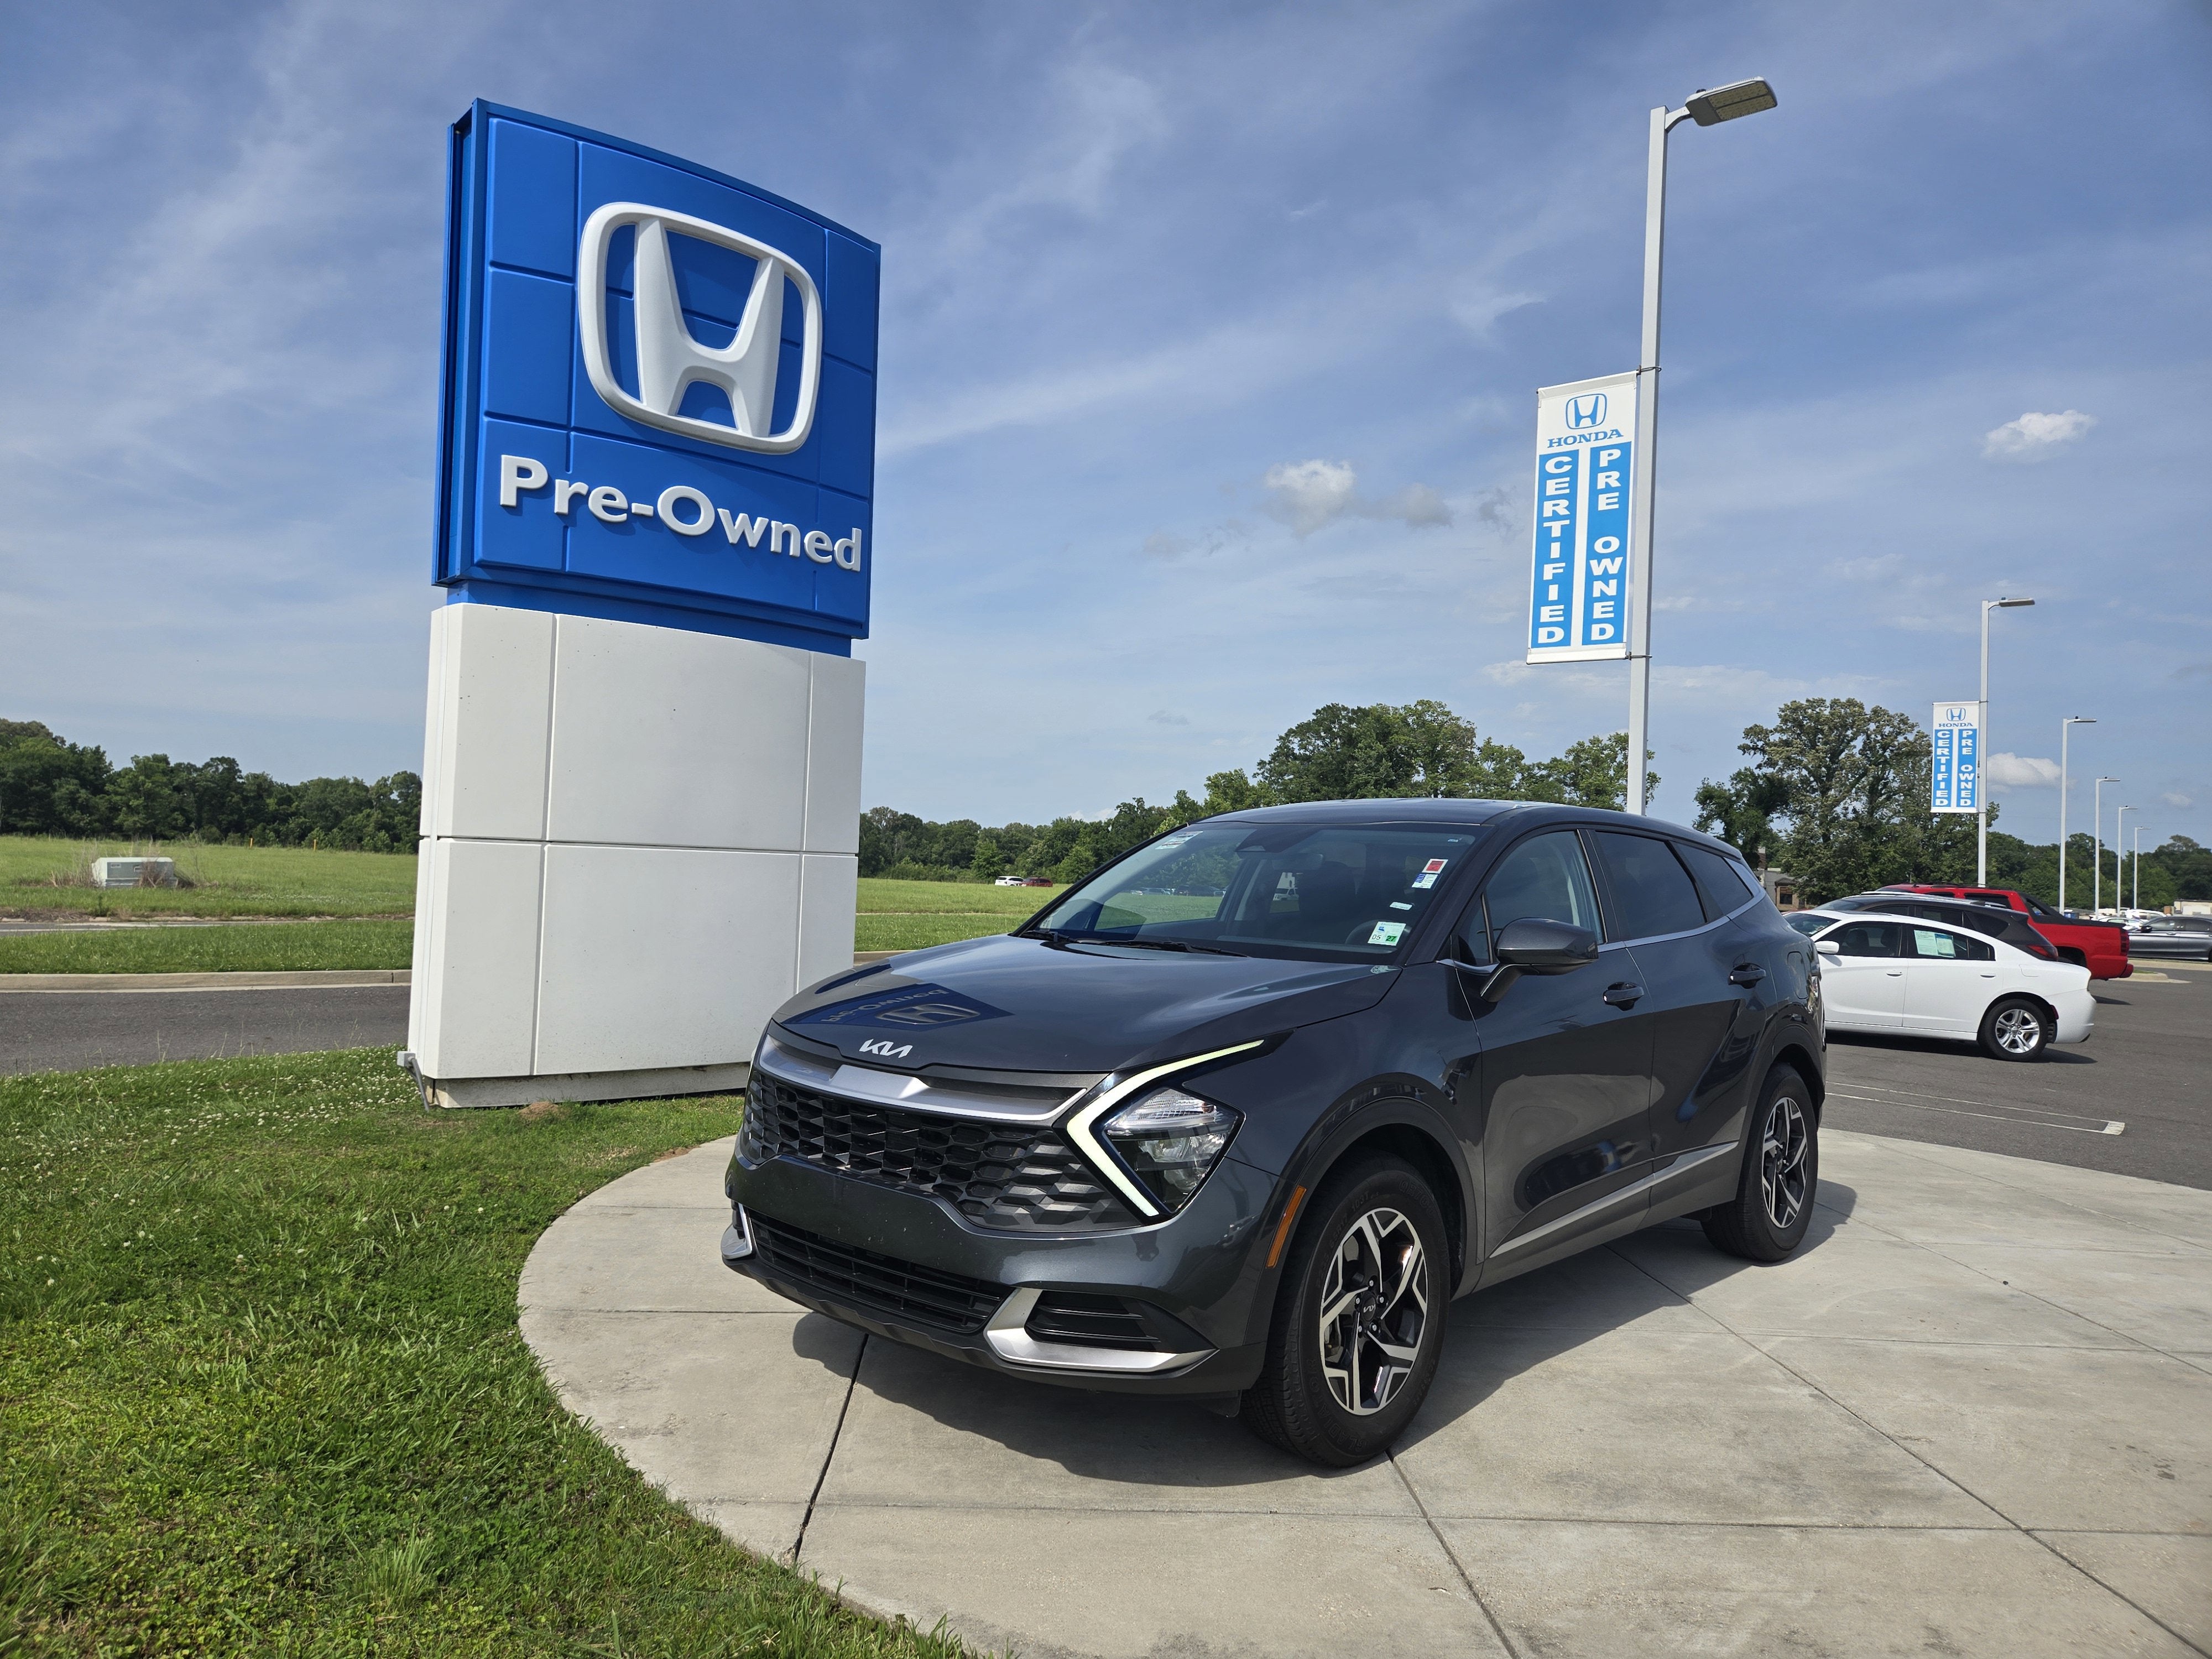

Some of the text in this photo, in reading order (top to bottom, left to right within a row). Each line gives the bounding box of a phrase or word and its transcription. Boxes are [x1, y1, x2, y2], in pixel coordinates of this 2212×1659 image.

[1547, 429, 1624, 448] HONDA
[500, 455, 862, 572] Pre-Owned
[1537, 456, 1572, 644] CERTIFIED
[1589, 449, 1623, 641] PRE OWNED
[1936, 731, 1950, 806] CERTIFIED
[1959, 731, 1974, 806] PRE OWNED
[859, 1039, 913, 1058] KIA
